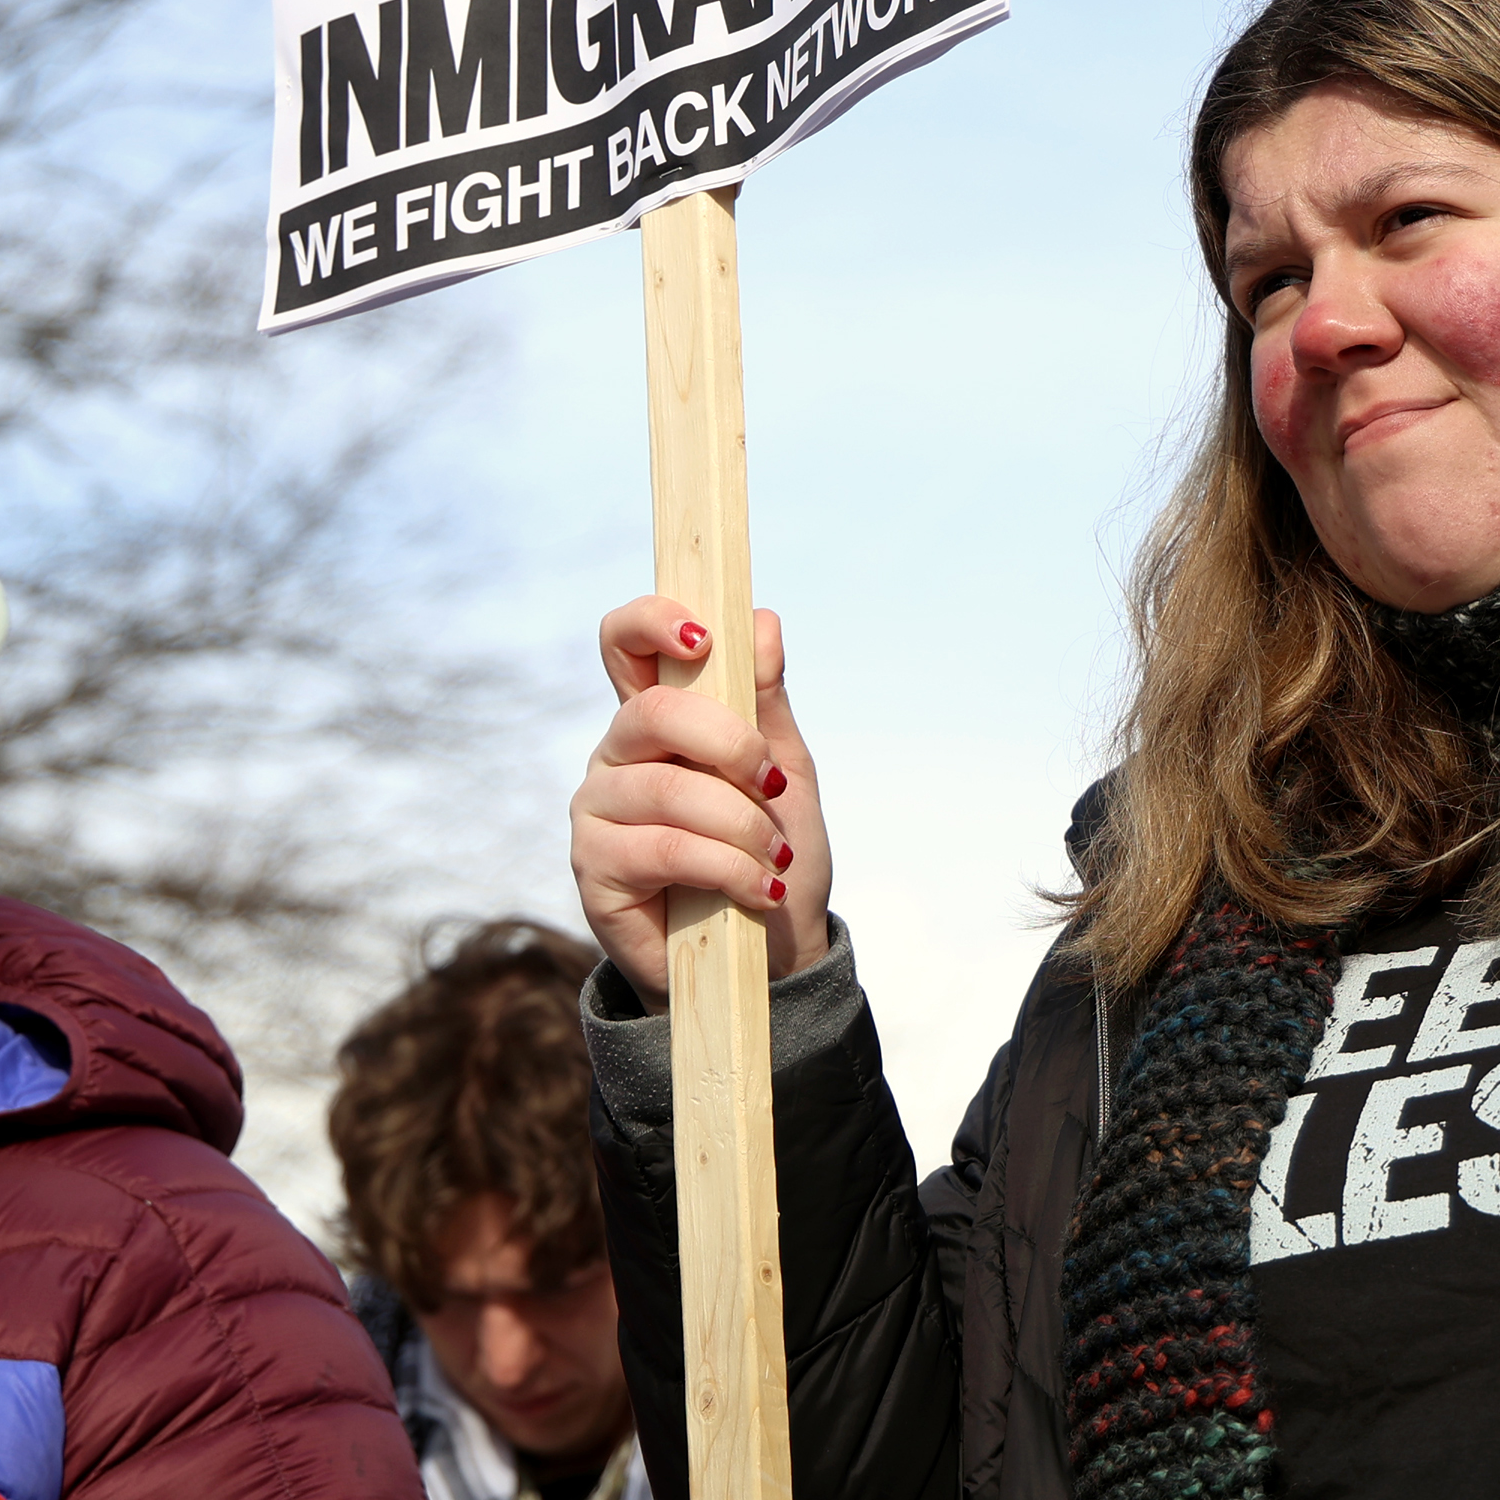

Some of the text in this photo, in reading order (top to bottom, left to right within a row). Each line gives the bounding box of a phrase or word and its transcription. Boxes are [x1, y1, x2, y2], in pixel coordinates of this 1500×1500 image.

[289, 201, 378, 287] WE
[396, 144, 594, 252] FIGHT
[607, 72, 756, 198] BACK
